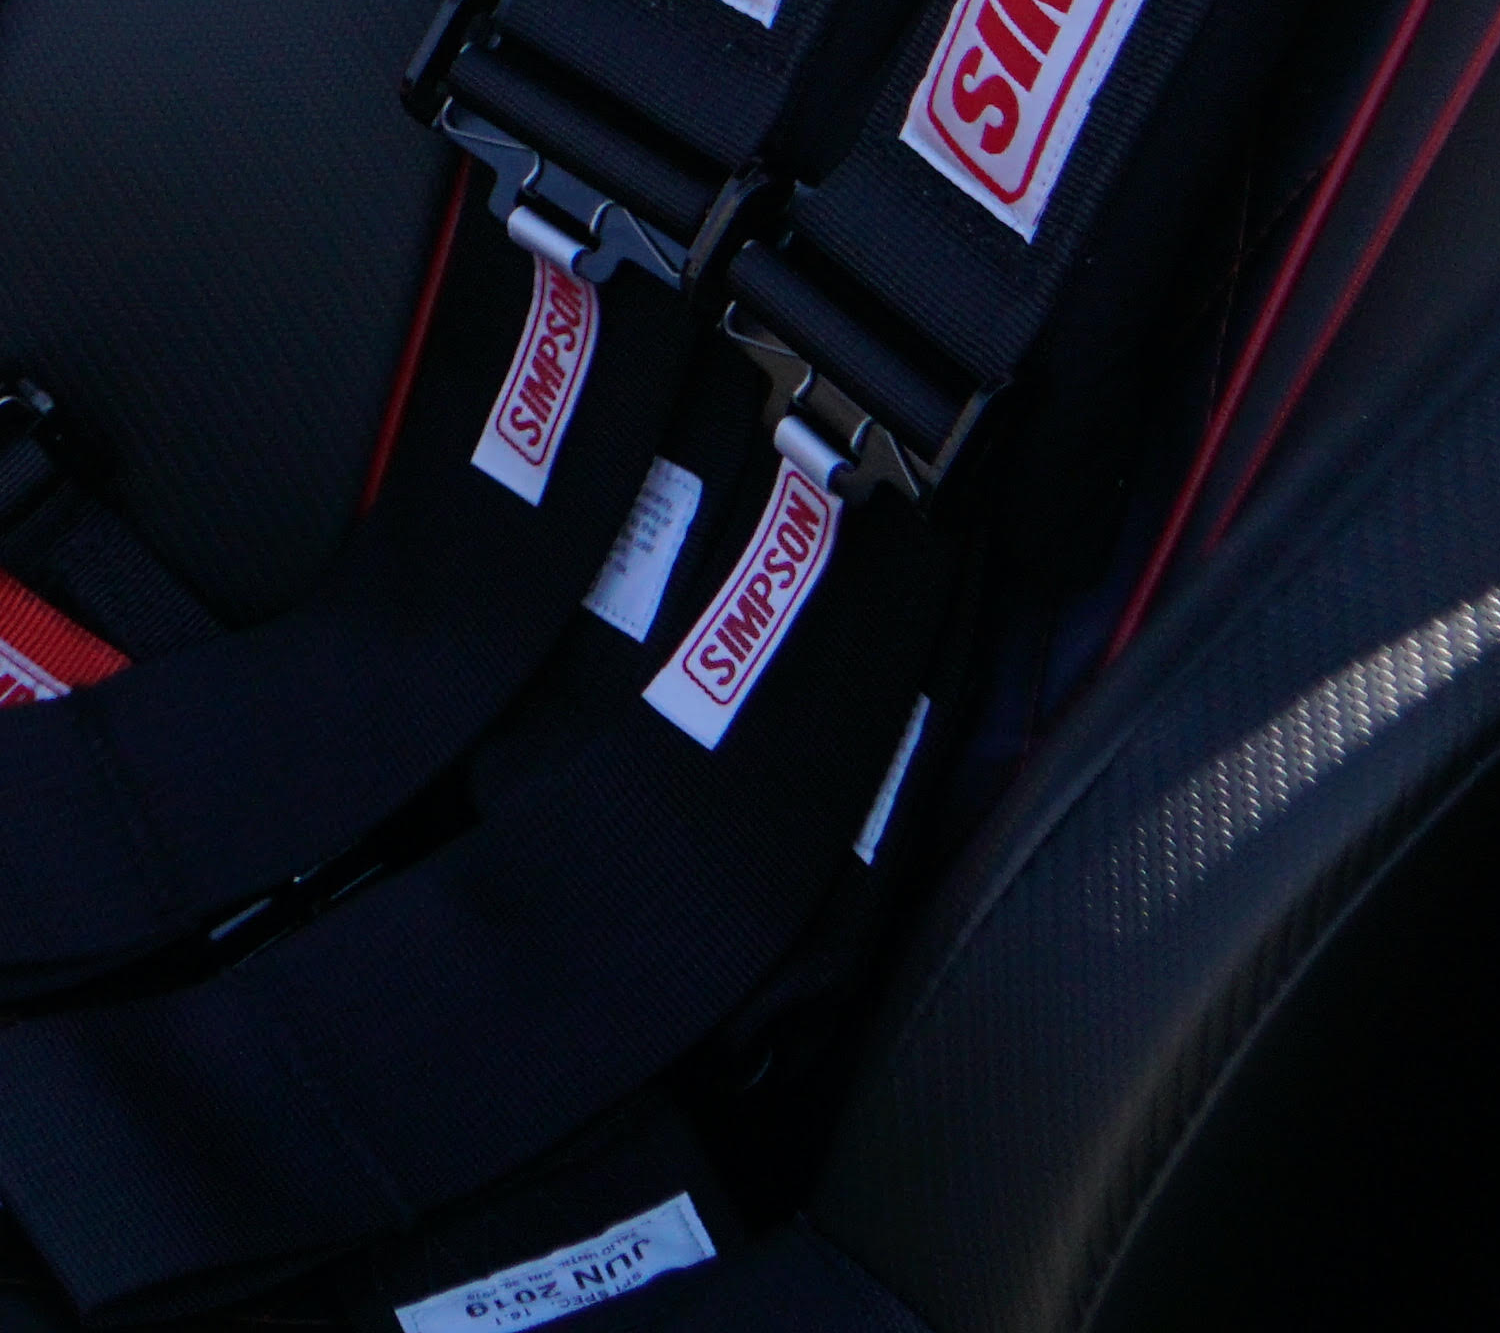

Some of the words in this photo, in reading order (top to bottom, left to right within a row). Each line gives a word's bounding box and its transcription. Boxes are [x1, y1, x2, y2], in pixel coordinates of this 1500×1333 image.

[509, 264, 583, 448] SIMPSON
[699, 488, 826, 689] SIMPSON
[465, 1281, 561, 1318] 2019
[572, 1238, 651, 1291] JUN
